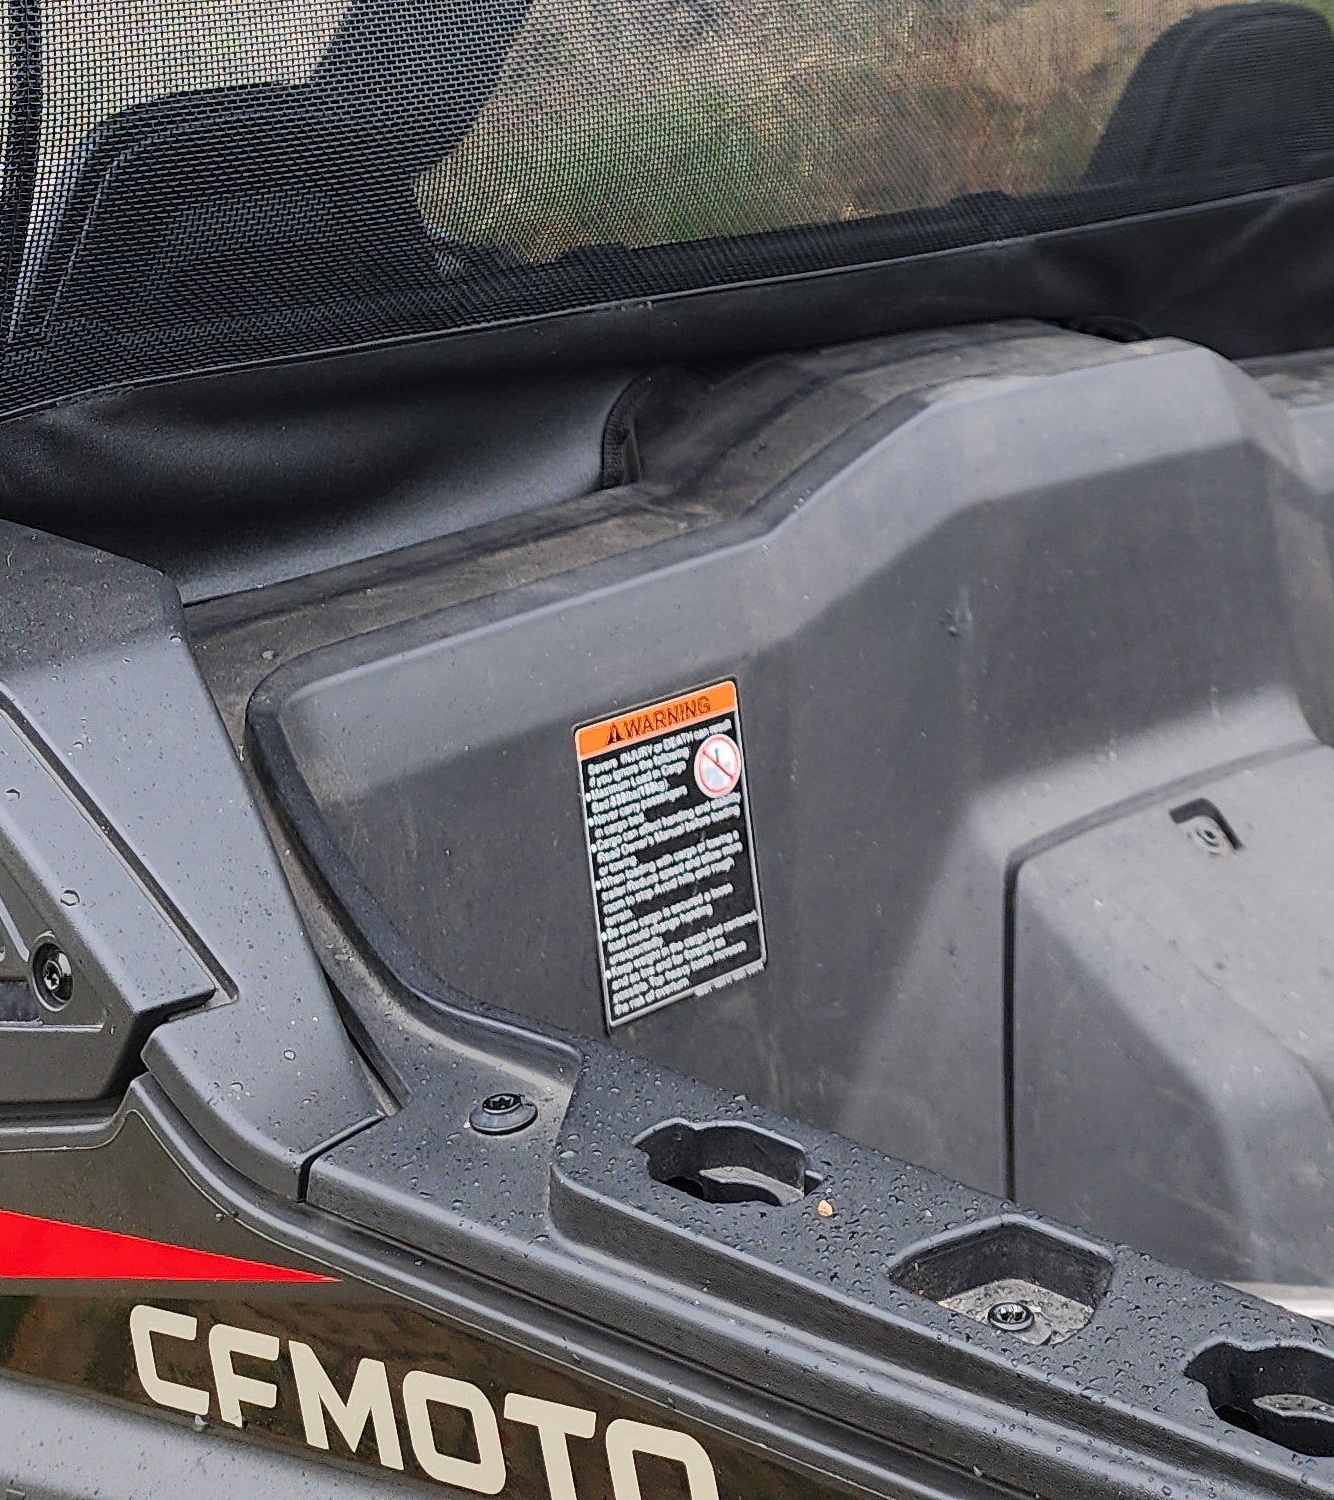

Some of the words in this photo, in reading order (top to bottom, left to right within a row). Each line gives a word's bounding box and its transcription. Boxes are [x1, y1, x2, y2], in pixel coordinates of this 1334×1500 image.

[624, 696, 711, 737] WARNING
[663, 731, 693, 750] DEATH
[130, 1304, 720, 1500] CFMOTO
